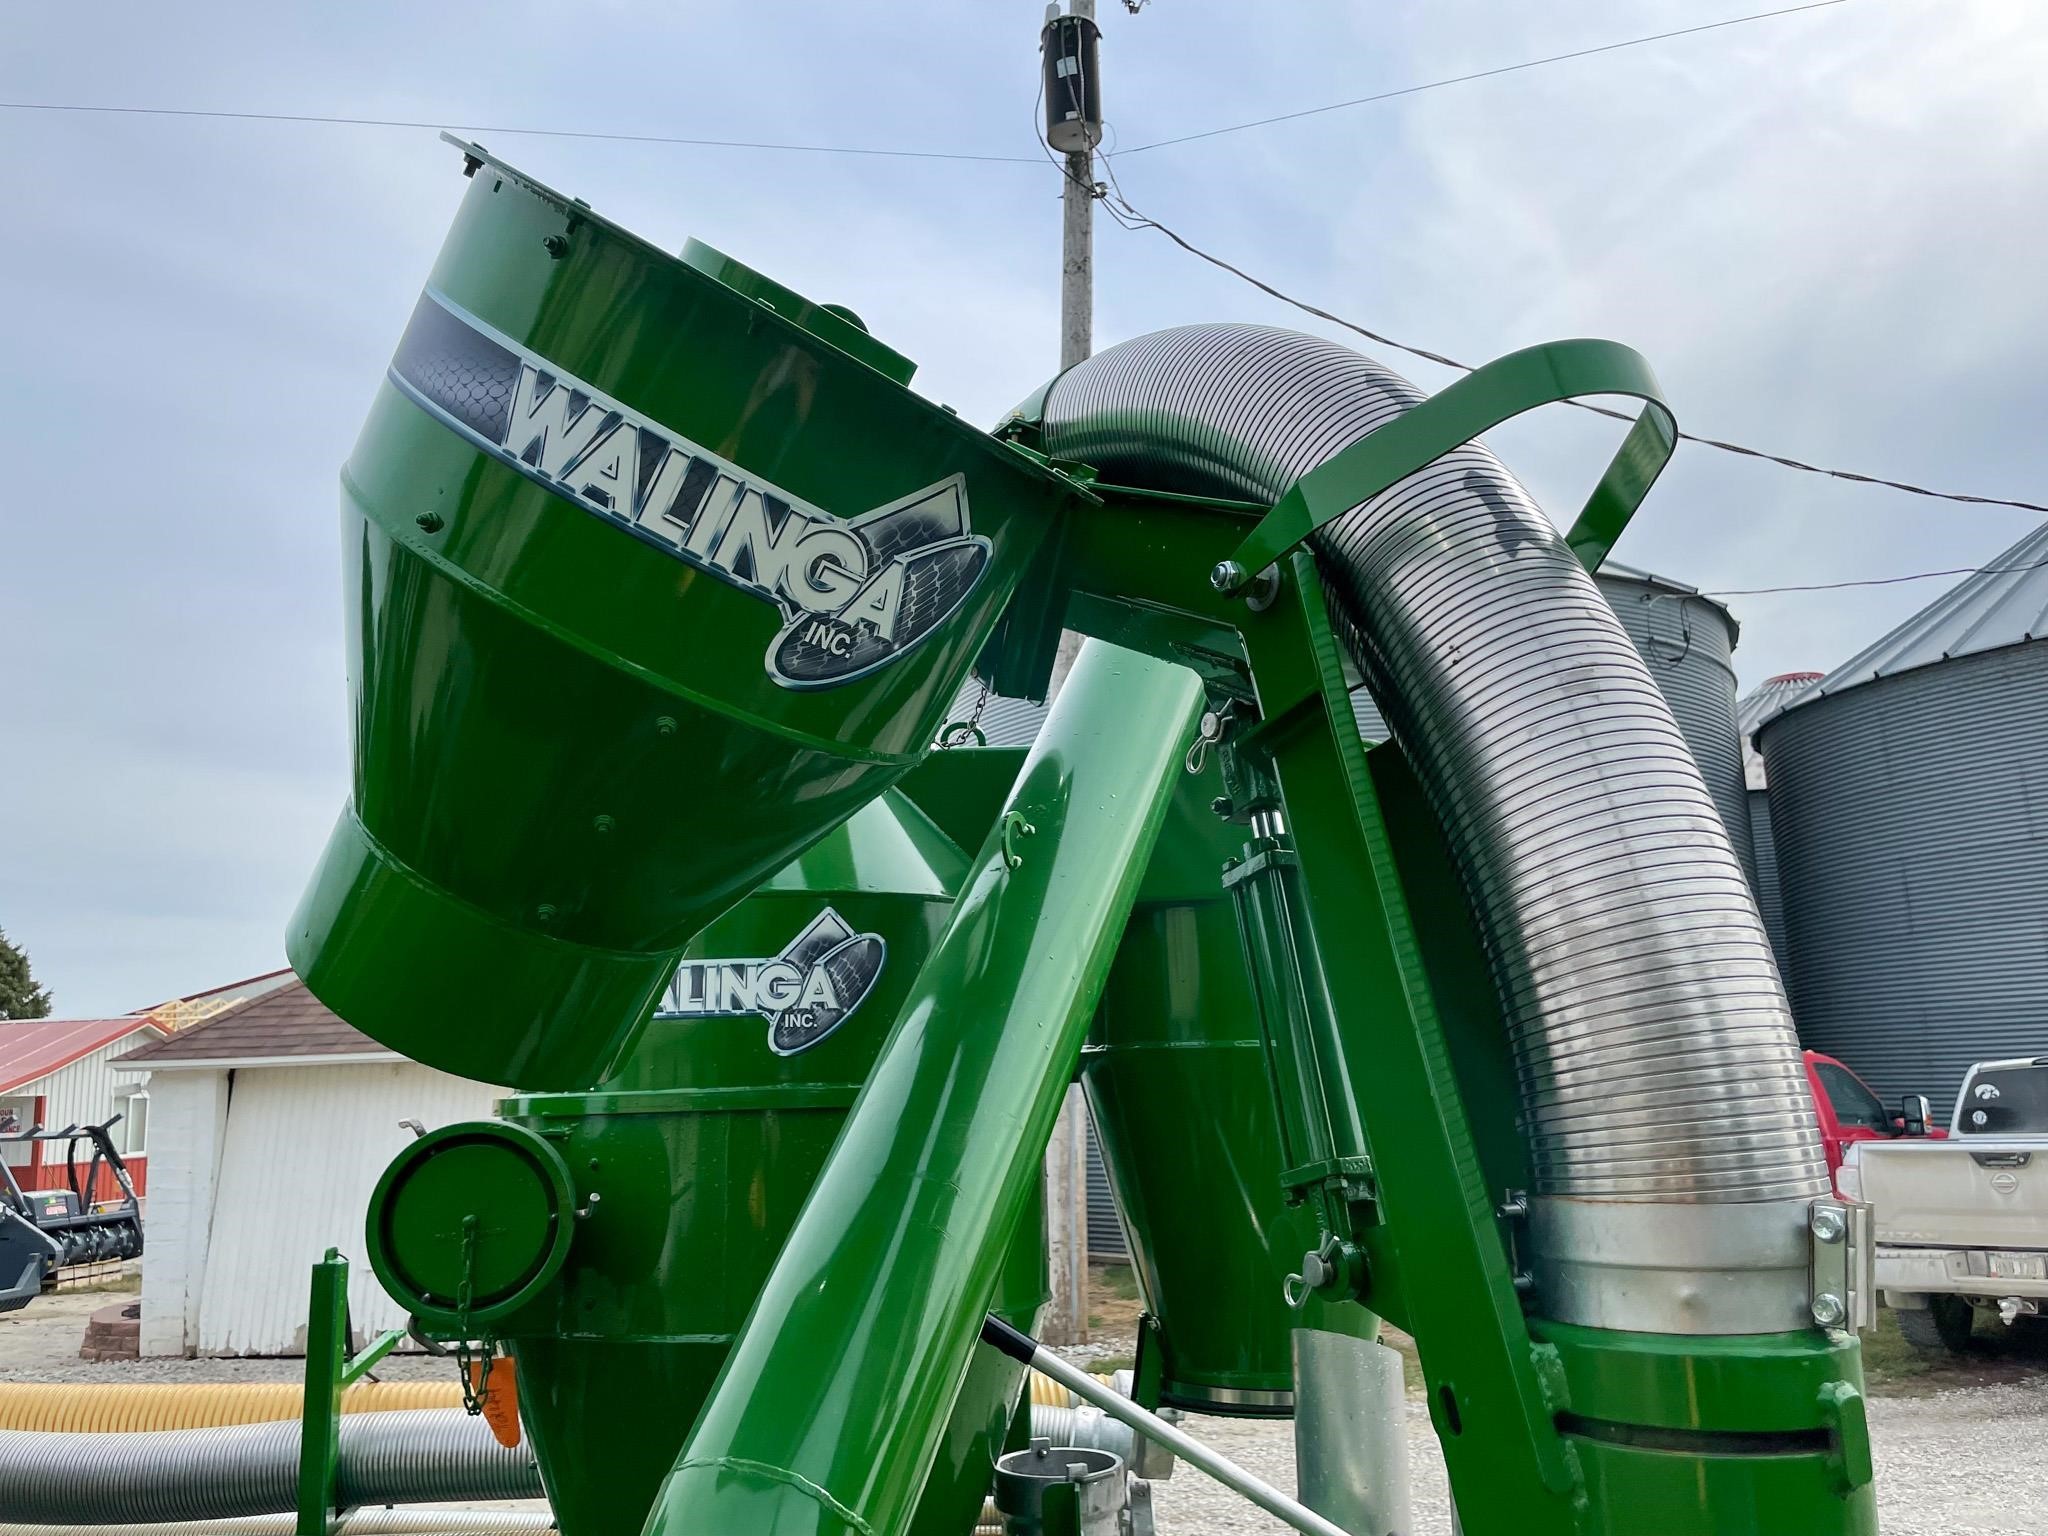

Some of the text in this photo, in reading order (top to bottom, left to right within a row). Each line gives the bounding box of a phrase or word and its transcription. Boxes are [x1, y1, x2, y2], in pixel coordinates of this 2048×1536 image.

[501, 360, 907, 642] WALINGA
[804, 621, 851, 659] INC.
[784, 1013, 818, 1029] INC.
